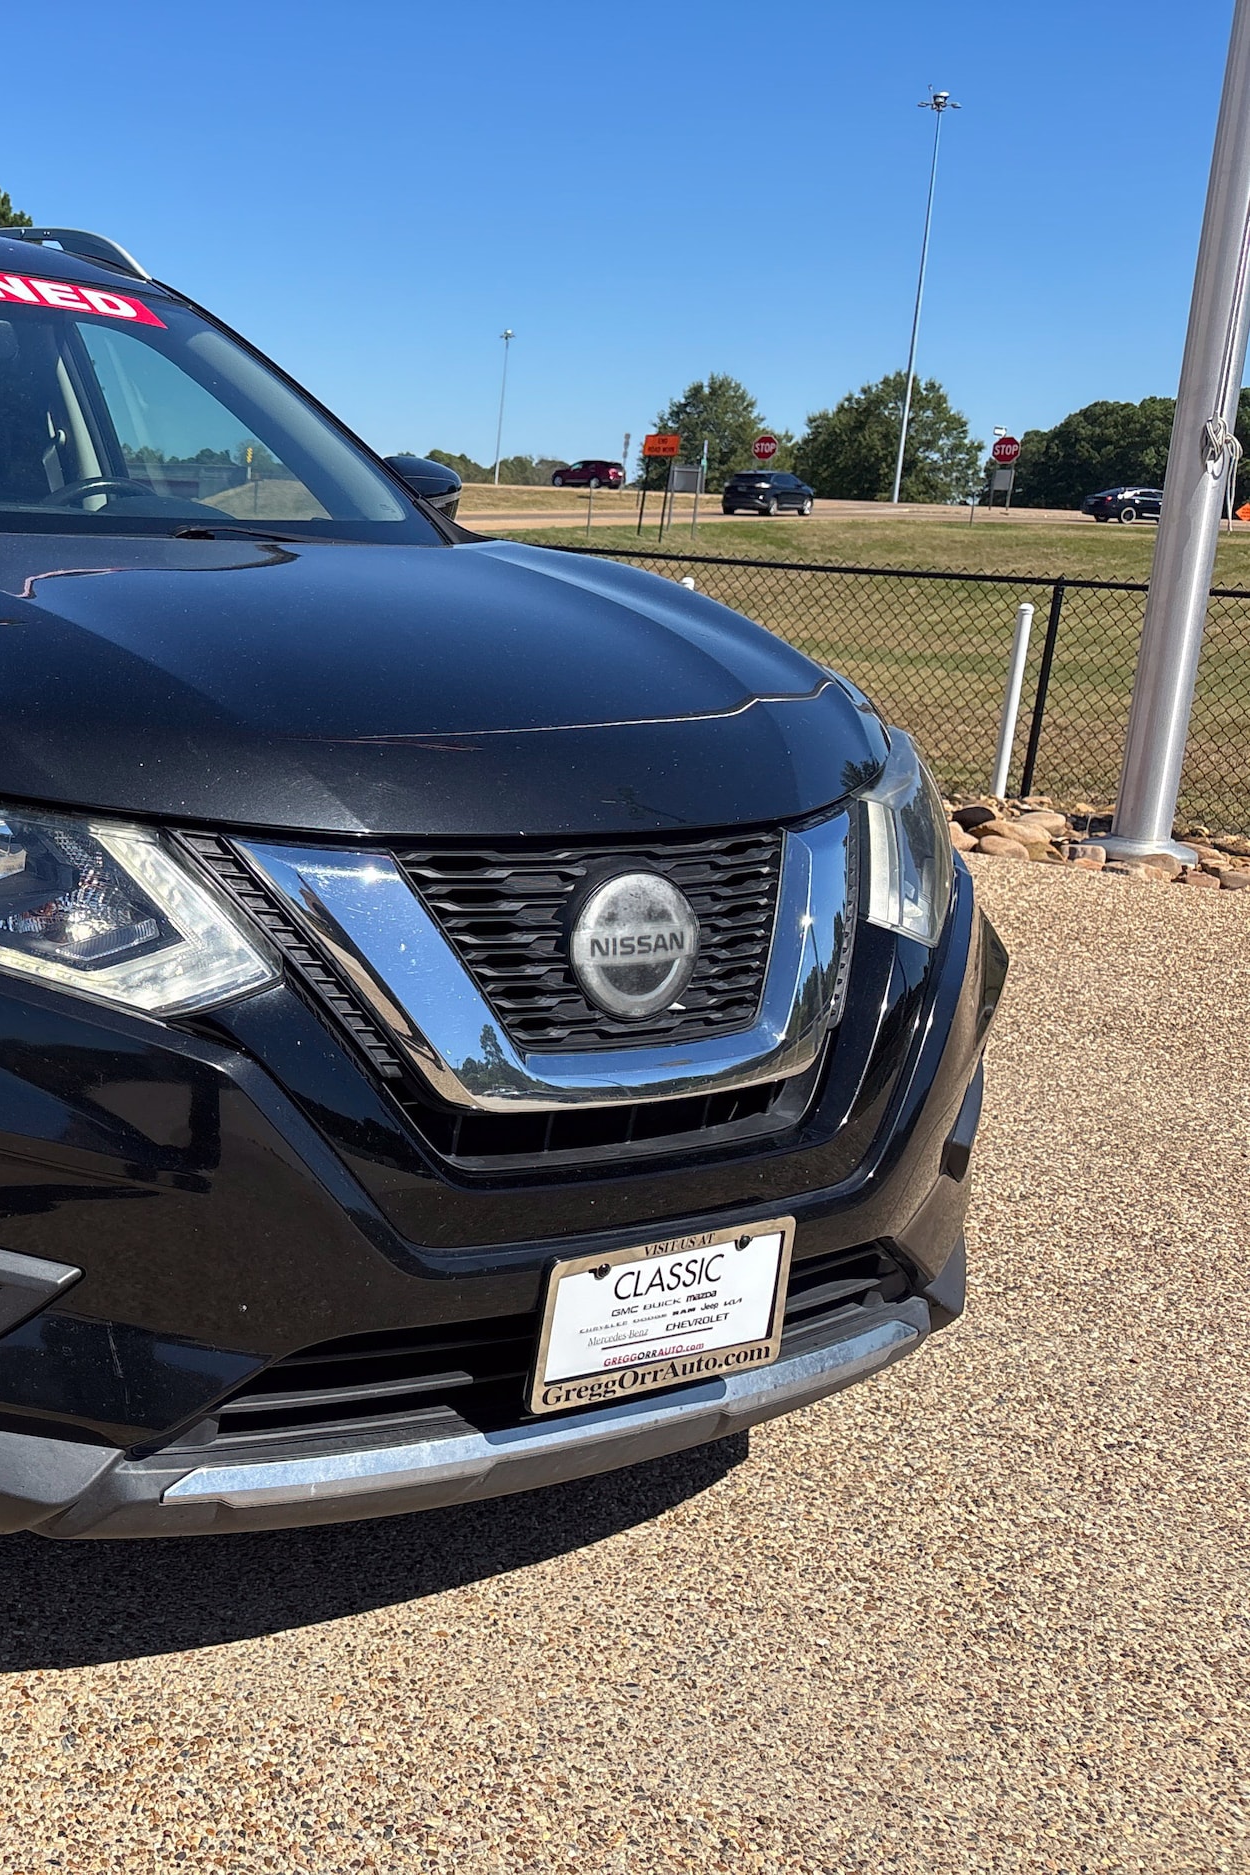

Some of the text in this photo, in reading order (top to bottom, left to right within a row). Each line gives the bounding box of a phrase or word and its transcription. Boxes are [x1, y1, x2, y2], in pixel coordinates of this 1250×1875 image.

[754, 442, 776, 453] STOP
[993, 444, 1019, 456] STOP
[590, 931, 685, 957] NISSAN
[644, 1233, 715, 1257] VISIT US AT
[614, 1254, 725, 1300] CLASSIC
[611, 1305, 639, 1317] GMC
[643, 1297, 682, 1311] BUICK
[700, 1302, 719, 1311] Jeep
[587, 1312, 730, 1347] Mercedes-Benz CHEVROLET
[603, 1342, 705, 1367] GREGGORRAUTO.com
[542, 1345, 771, 1406] GreggOrrAuto.com
